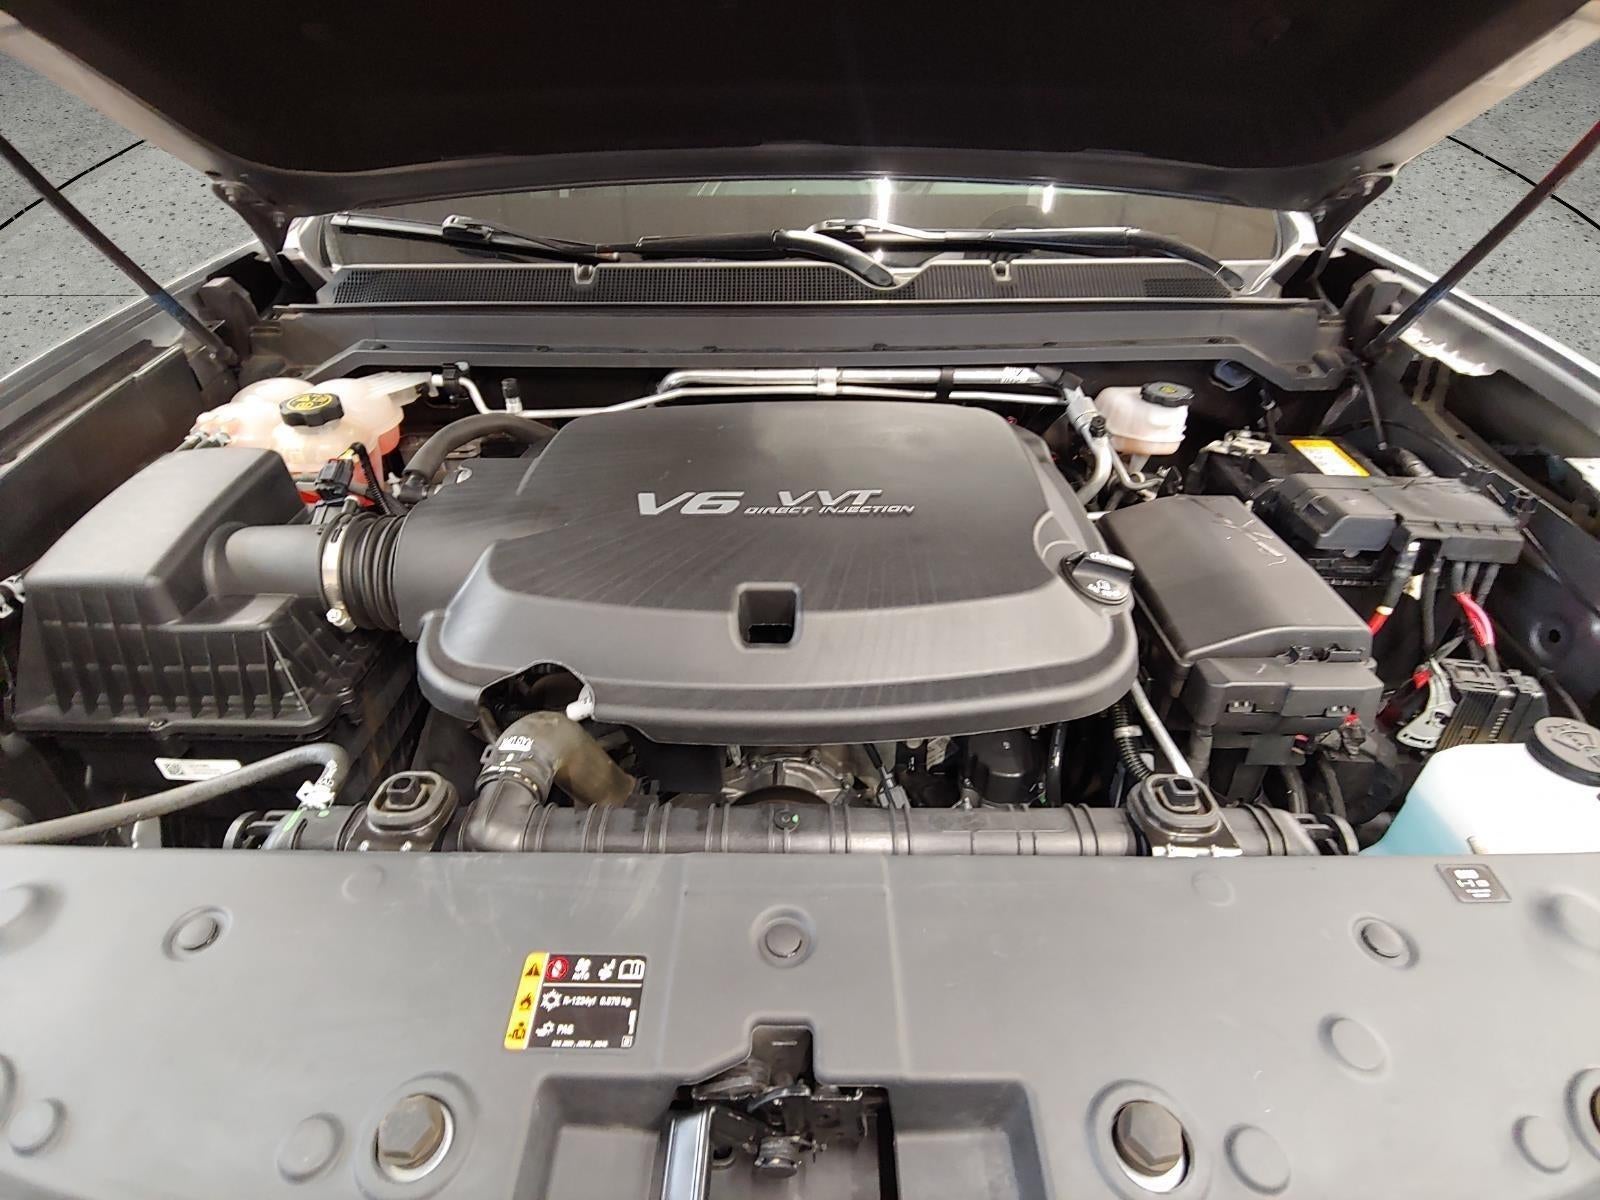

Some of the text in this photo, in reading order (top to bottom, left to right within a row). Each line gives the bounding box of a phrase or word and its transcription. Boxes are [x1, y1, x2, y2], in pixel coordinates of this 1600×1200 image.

[637, 489, 883, 516] V6 VVT
[743, 504, 915, 515] DIRECT INJECTION
